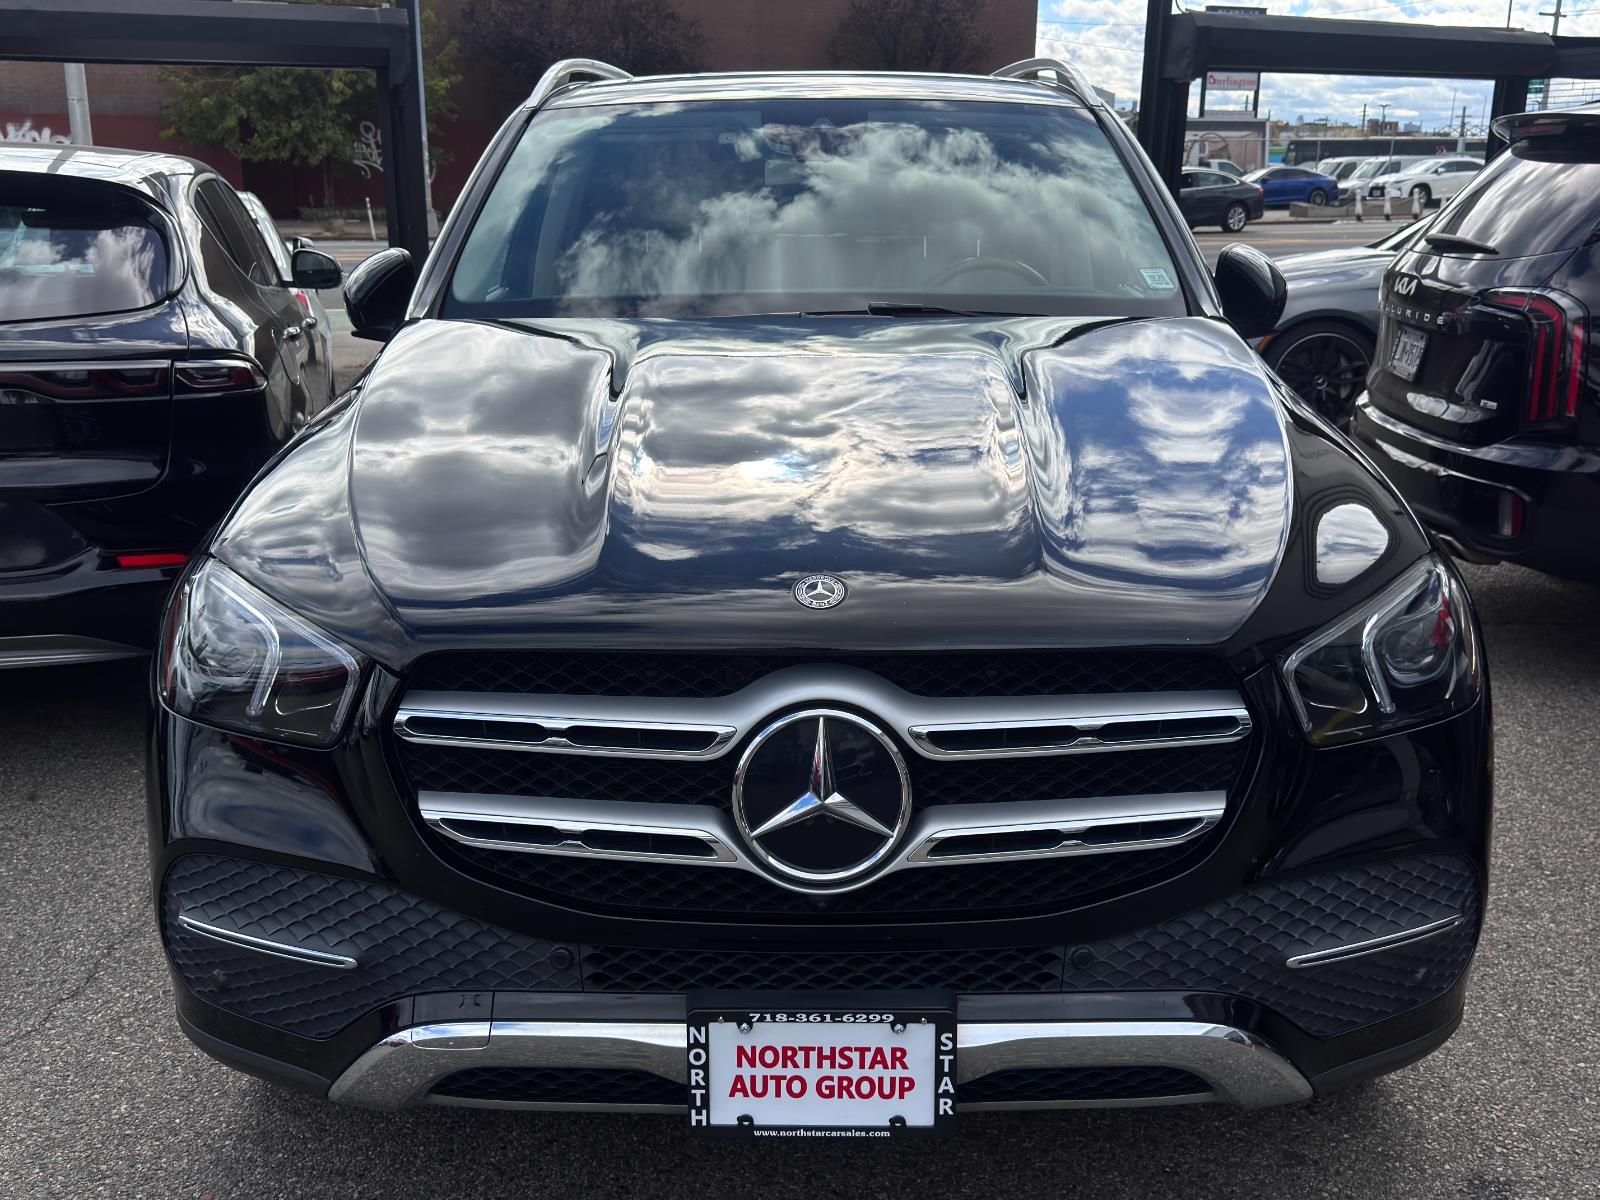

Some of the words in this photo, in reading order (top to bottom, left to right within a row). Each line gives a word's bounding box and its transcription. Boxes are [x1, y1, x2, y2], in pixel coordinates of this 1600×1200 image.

[748, 1013, 895, 1023] 718-361-6299
[736, 1045, 909, 1070] NORTHSTAR
[688, 1026, 707, 1126] NORTH
[938, 1032, 954, 1115] STAR
[728, 1074, 808, 1098] AUTO
[815, 1075, 915, 1100] GROUP
[753, 1128, 891, 1137] www.northstarcarsales.com
